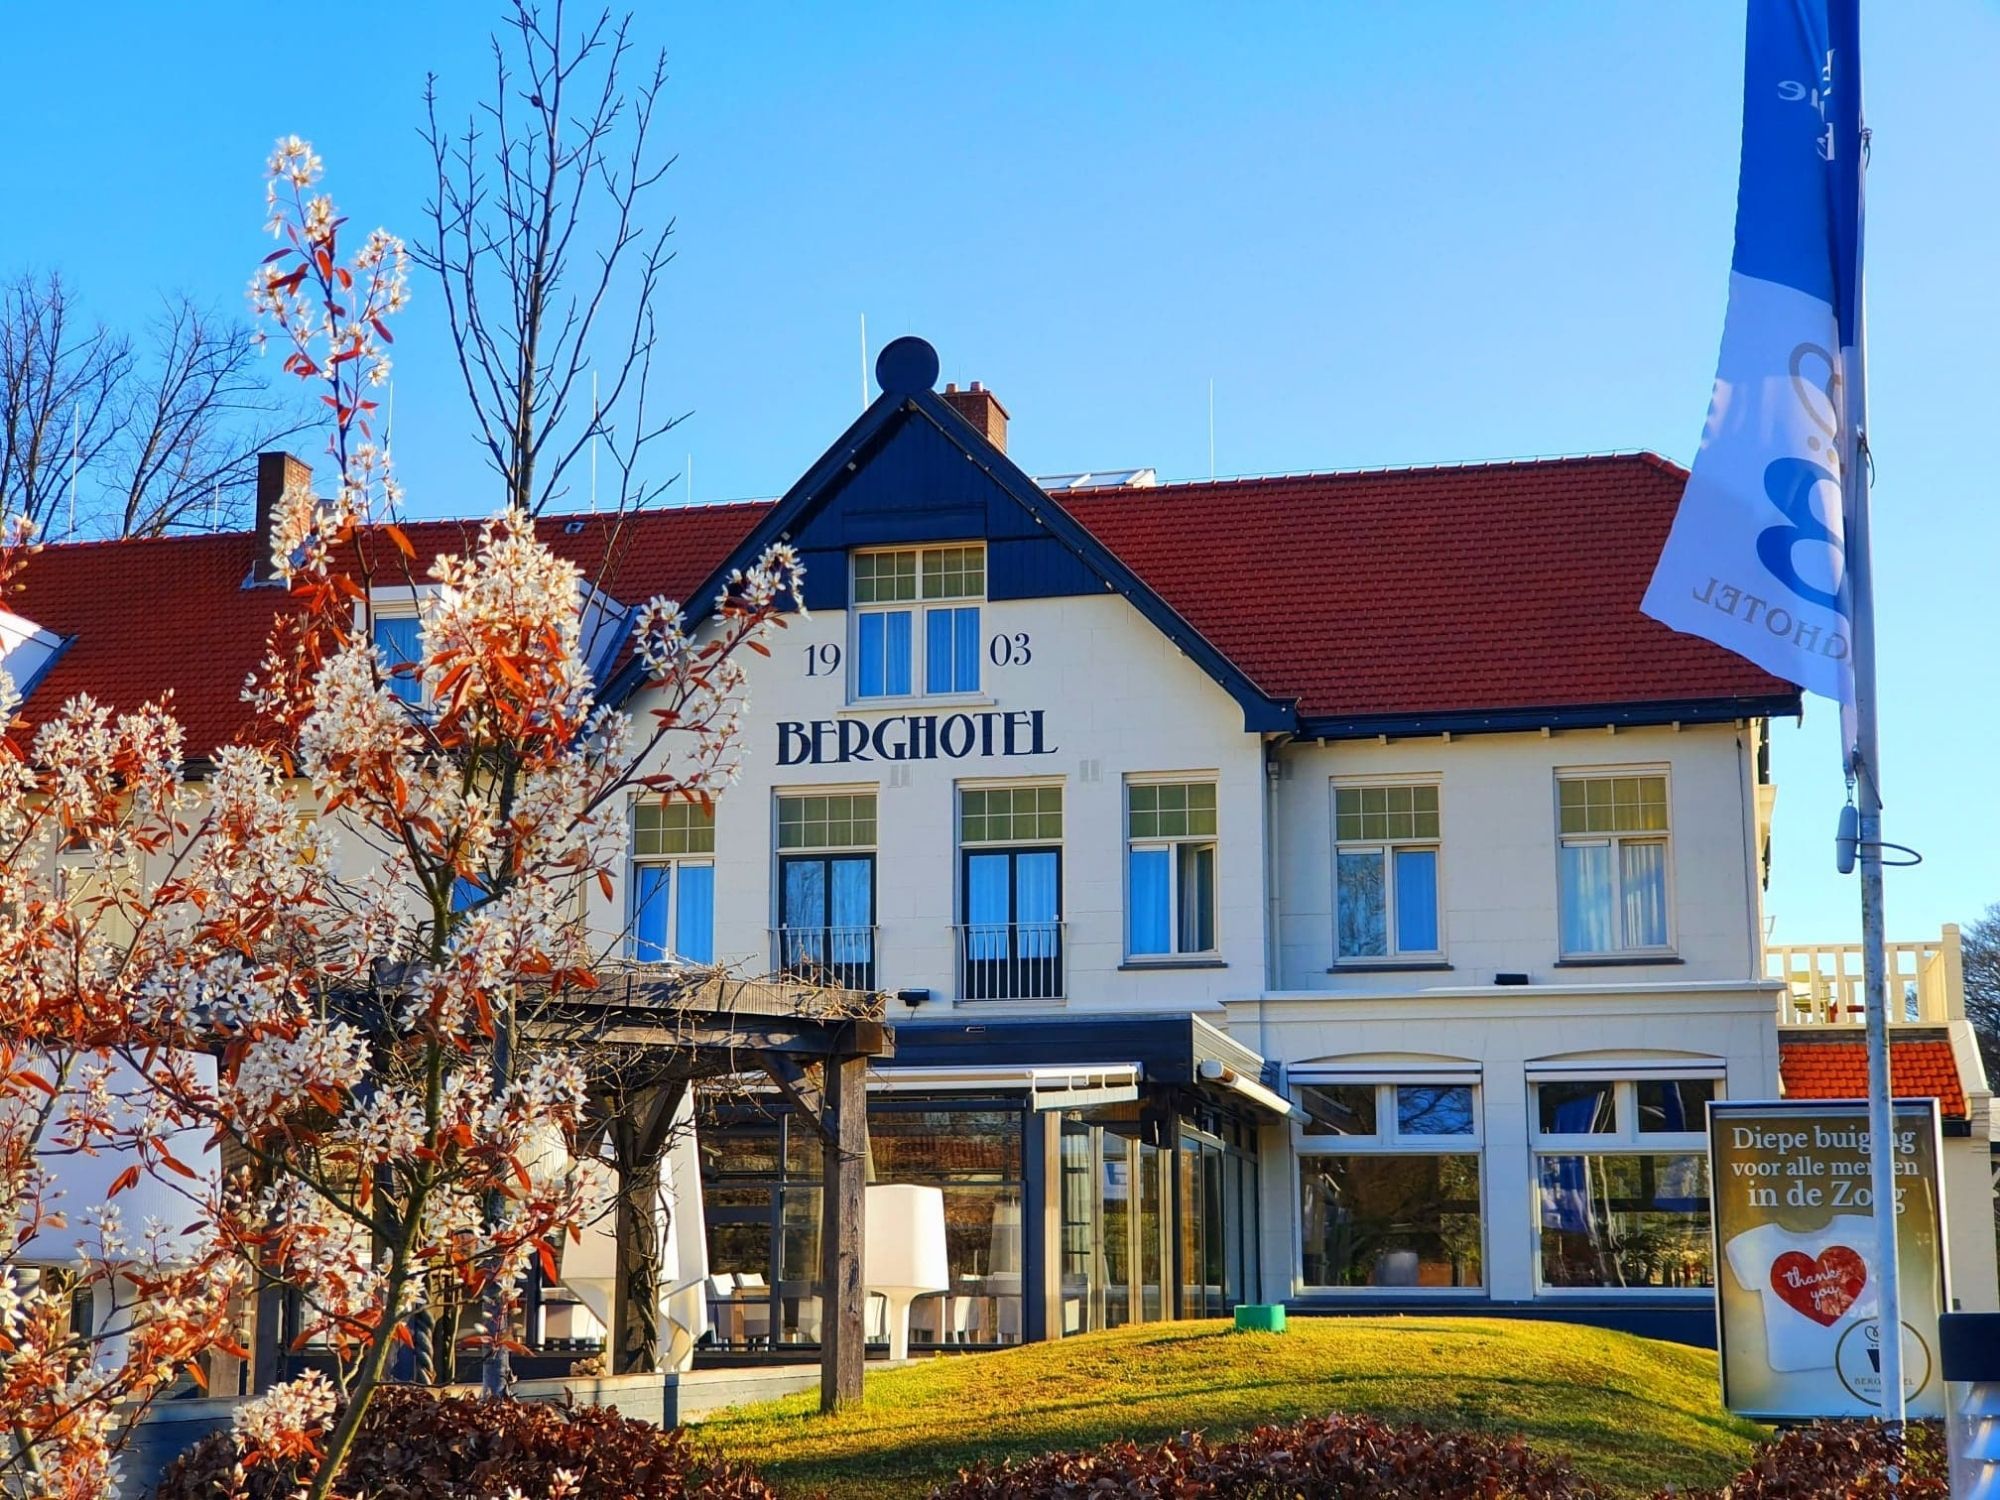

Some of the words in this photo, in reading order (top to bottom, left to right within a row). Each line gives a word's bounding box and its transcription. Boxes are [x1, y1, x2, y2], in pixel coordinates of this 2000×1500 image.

[802, 643, 842, 677] 19
[989, 632, 1033, 667] 03
[775, 709, 1060, 766] BERGHOTEL
[1732, 1126, 1809, 1155] Diepe
[1813, 1125, 1917, 1155] buigg
[1731, 1162, 1782, 1177] voor
[1786, 1156, 1825, 1176] alle
[1830, 1161, 1920, 1176] meen
[1748, 1180, 1779, 1207] in
[1786, 1180, 1823, 1207] de
[1831, 1181, 1908, 1215] Zog
[1781, 1259, 1842, 1289] thank
[1810, 1286, 1840, 1311] you
